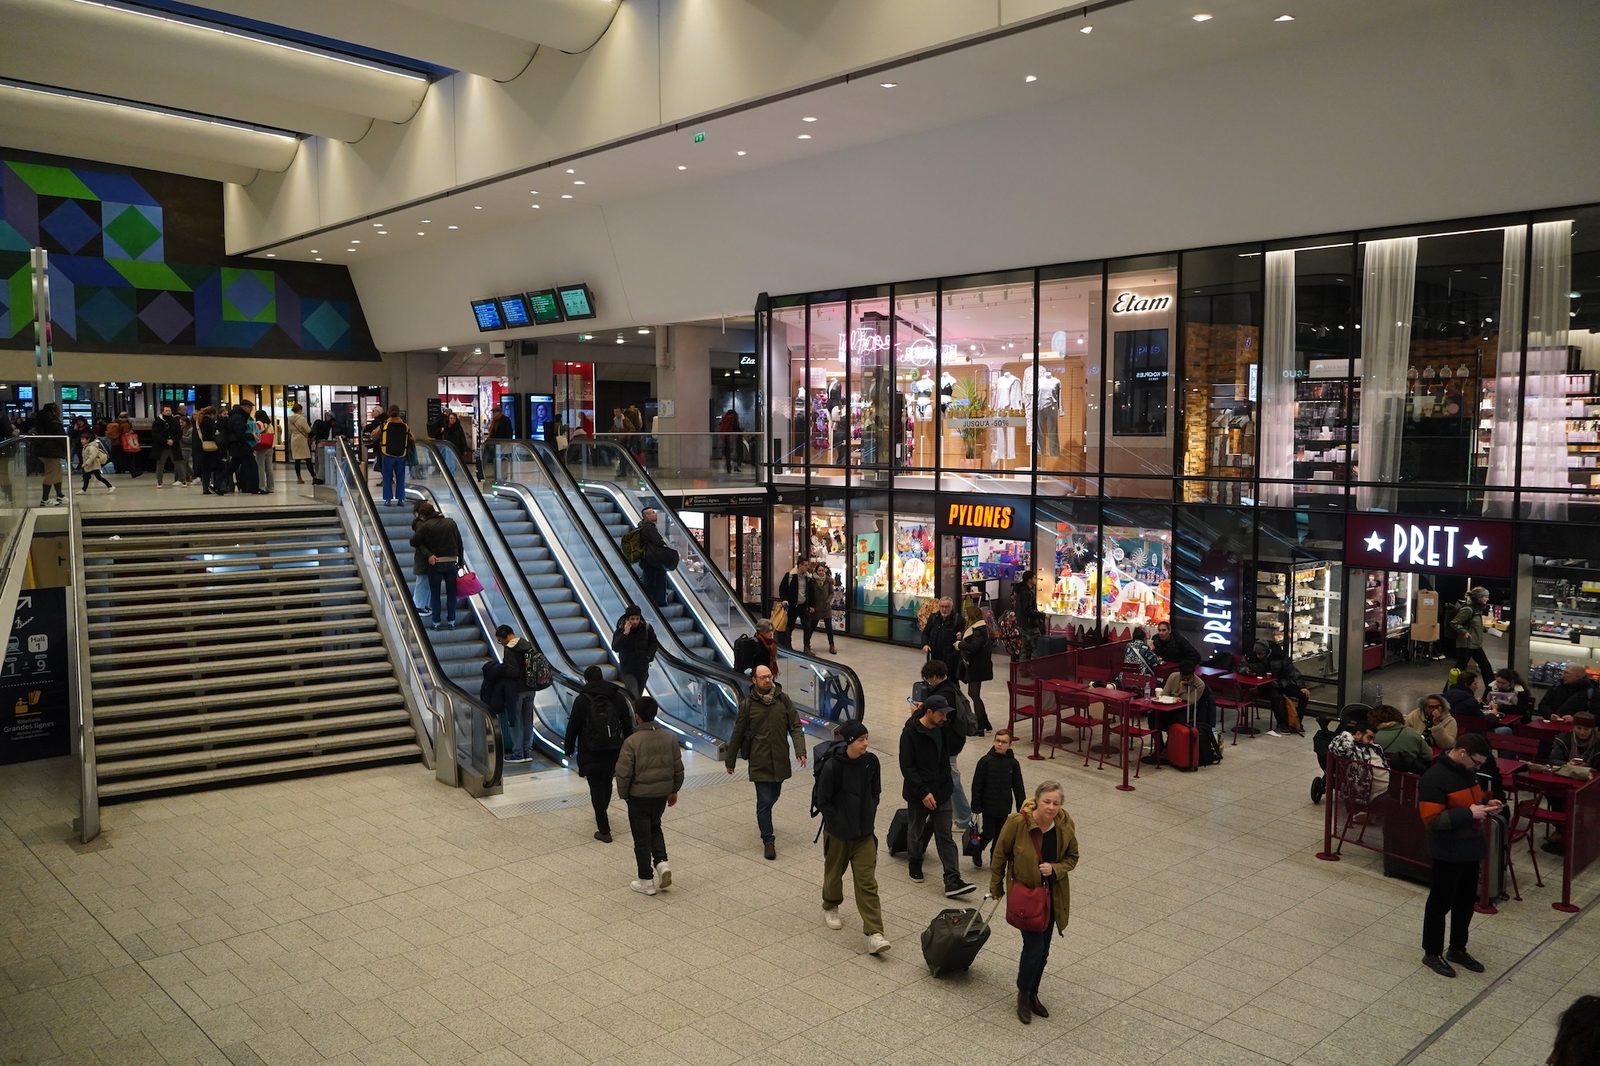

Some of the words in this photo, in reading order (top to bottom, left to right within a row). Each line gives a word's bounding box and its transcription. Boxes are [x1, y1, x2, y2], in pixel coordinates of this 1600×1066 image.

[1112, 292, 1170, 314] Etam
[948, 503, 1014, 529] PYLONES
[1393, 523, 1460, 567] PRET
[1203, 594, 1232, 645] PRET
[7, 663, 15, 674] 1
[36, 660, 46, 672] 9
[3, 724, 33, 733] Grandes
[34, 721, 55, 730] lignes
